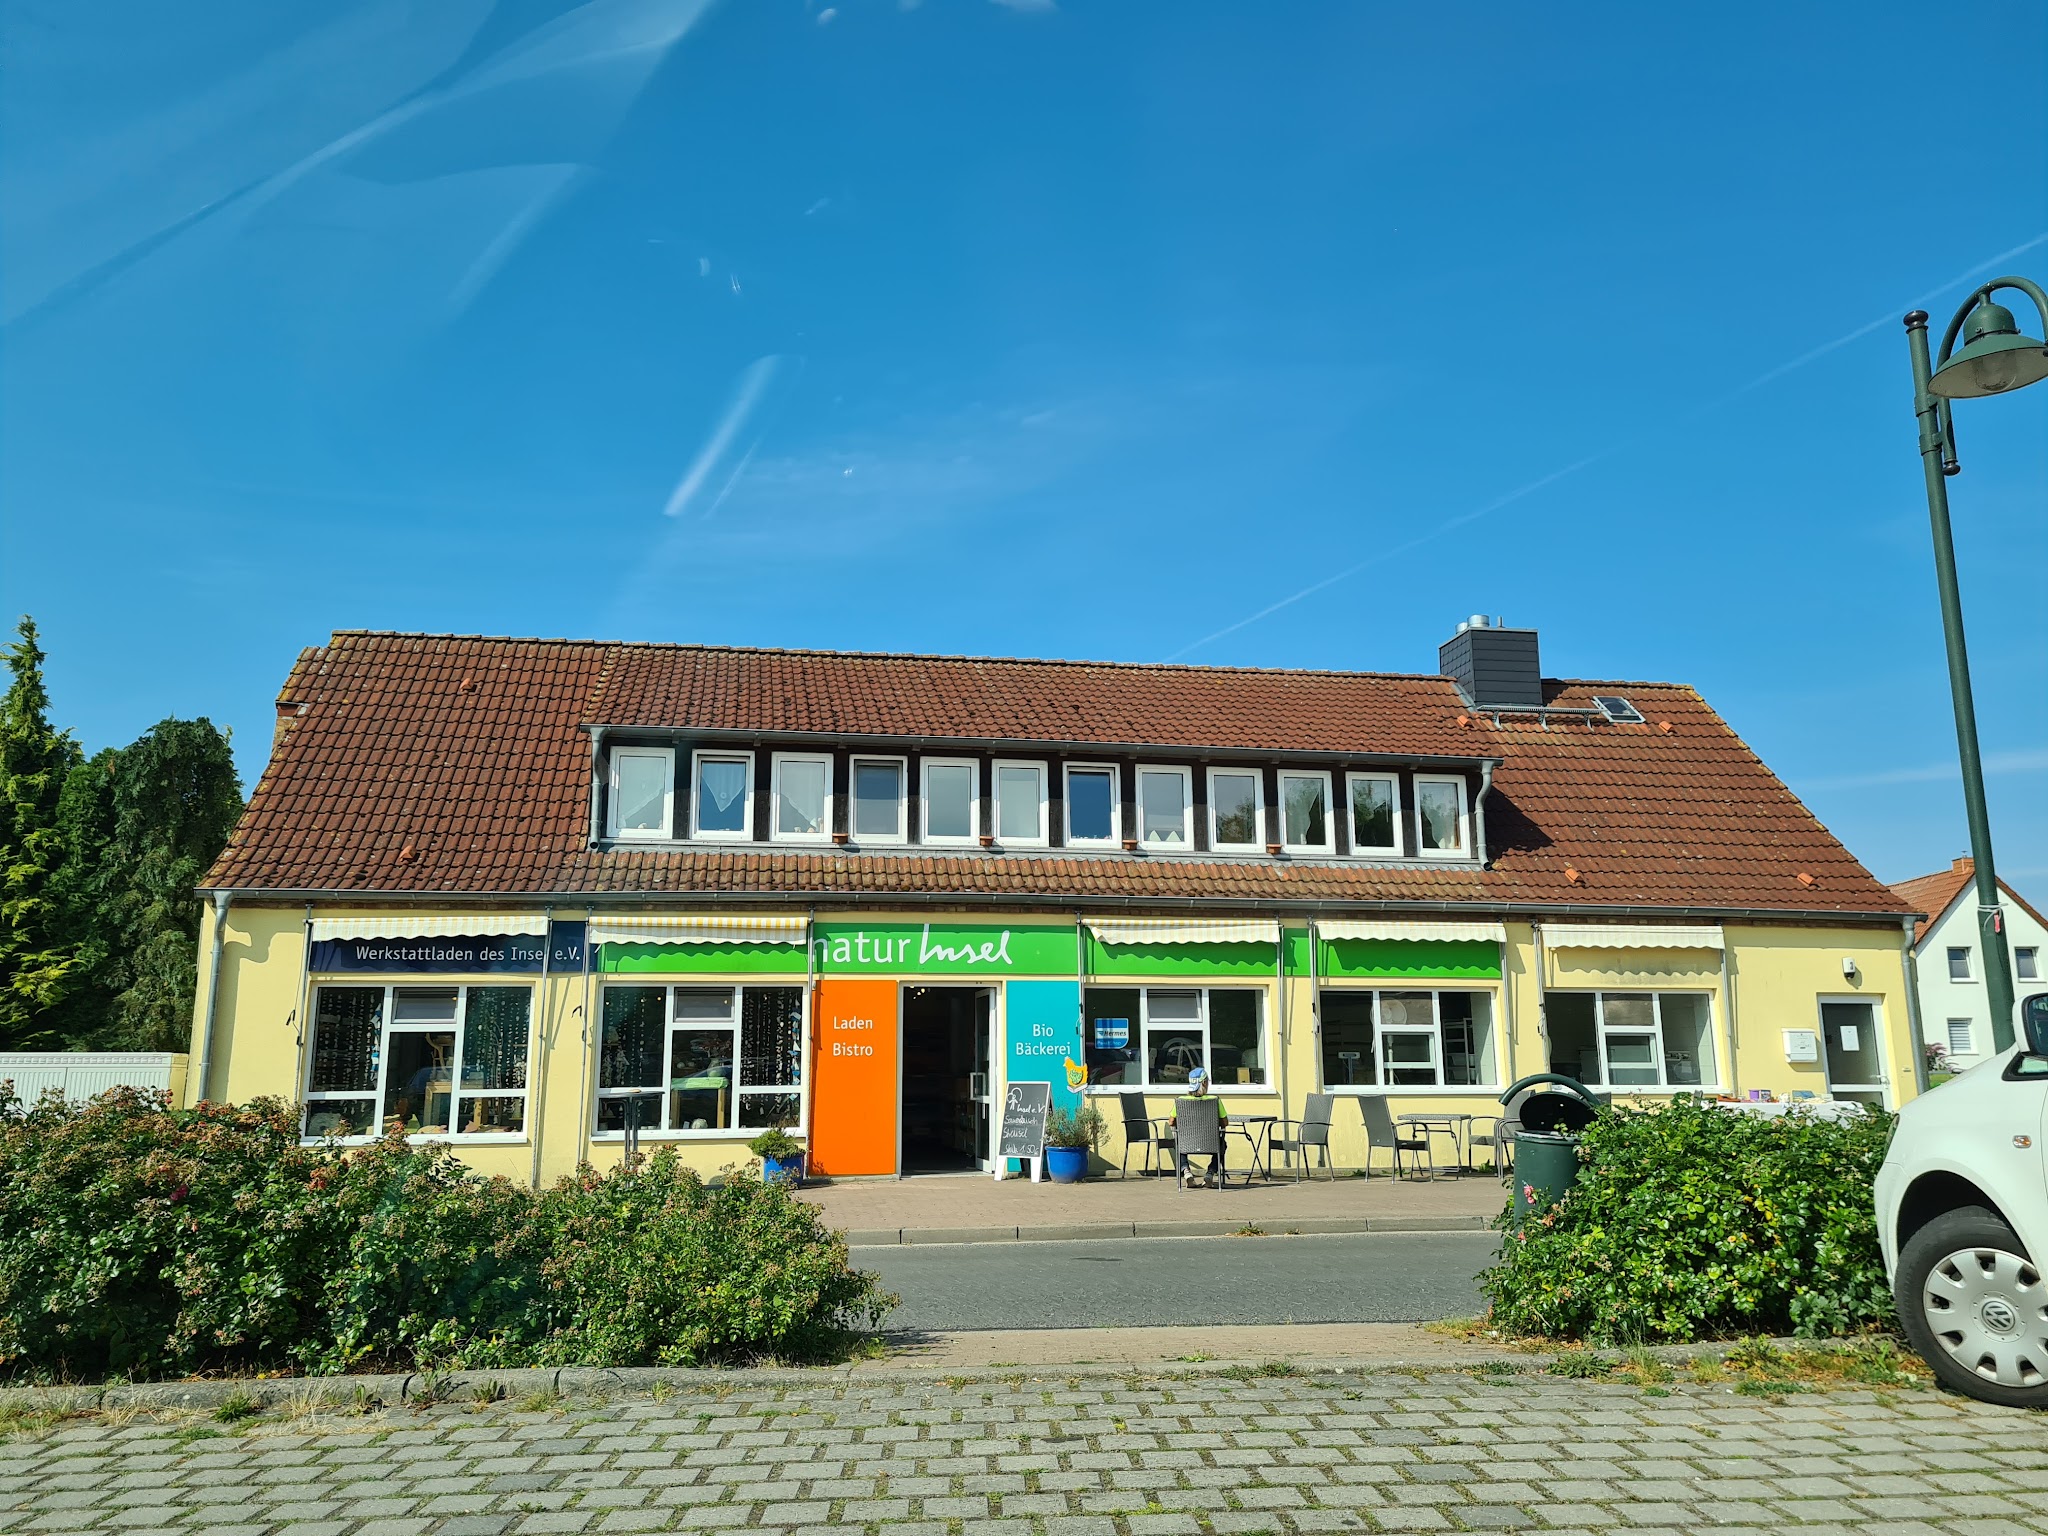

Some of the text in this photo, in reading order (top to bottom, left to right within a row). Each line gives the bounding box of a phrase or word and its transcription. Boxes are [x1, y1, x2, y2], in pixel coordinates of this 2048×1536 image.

[356, 946, 580, 961] Werkstattladen des Inse e.V.
[833, 1015, 873, 1030] Laden
[1032, 1023, 1054, 1037] Bio
[833, 1042, 874, 1057] Bistro
[1016, 1041, 1071, 1056] Bäckerei
